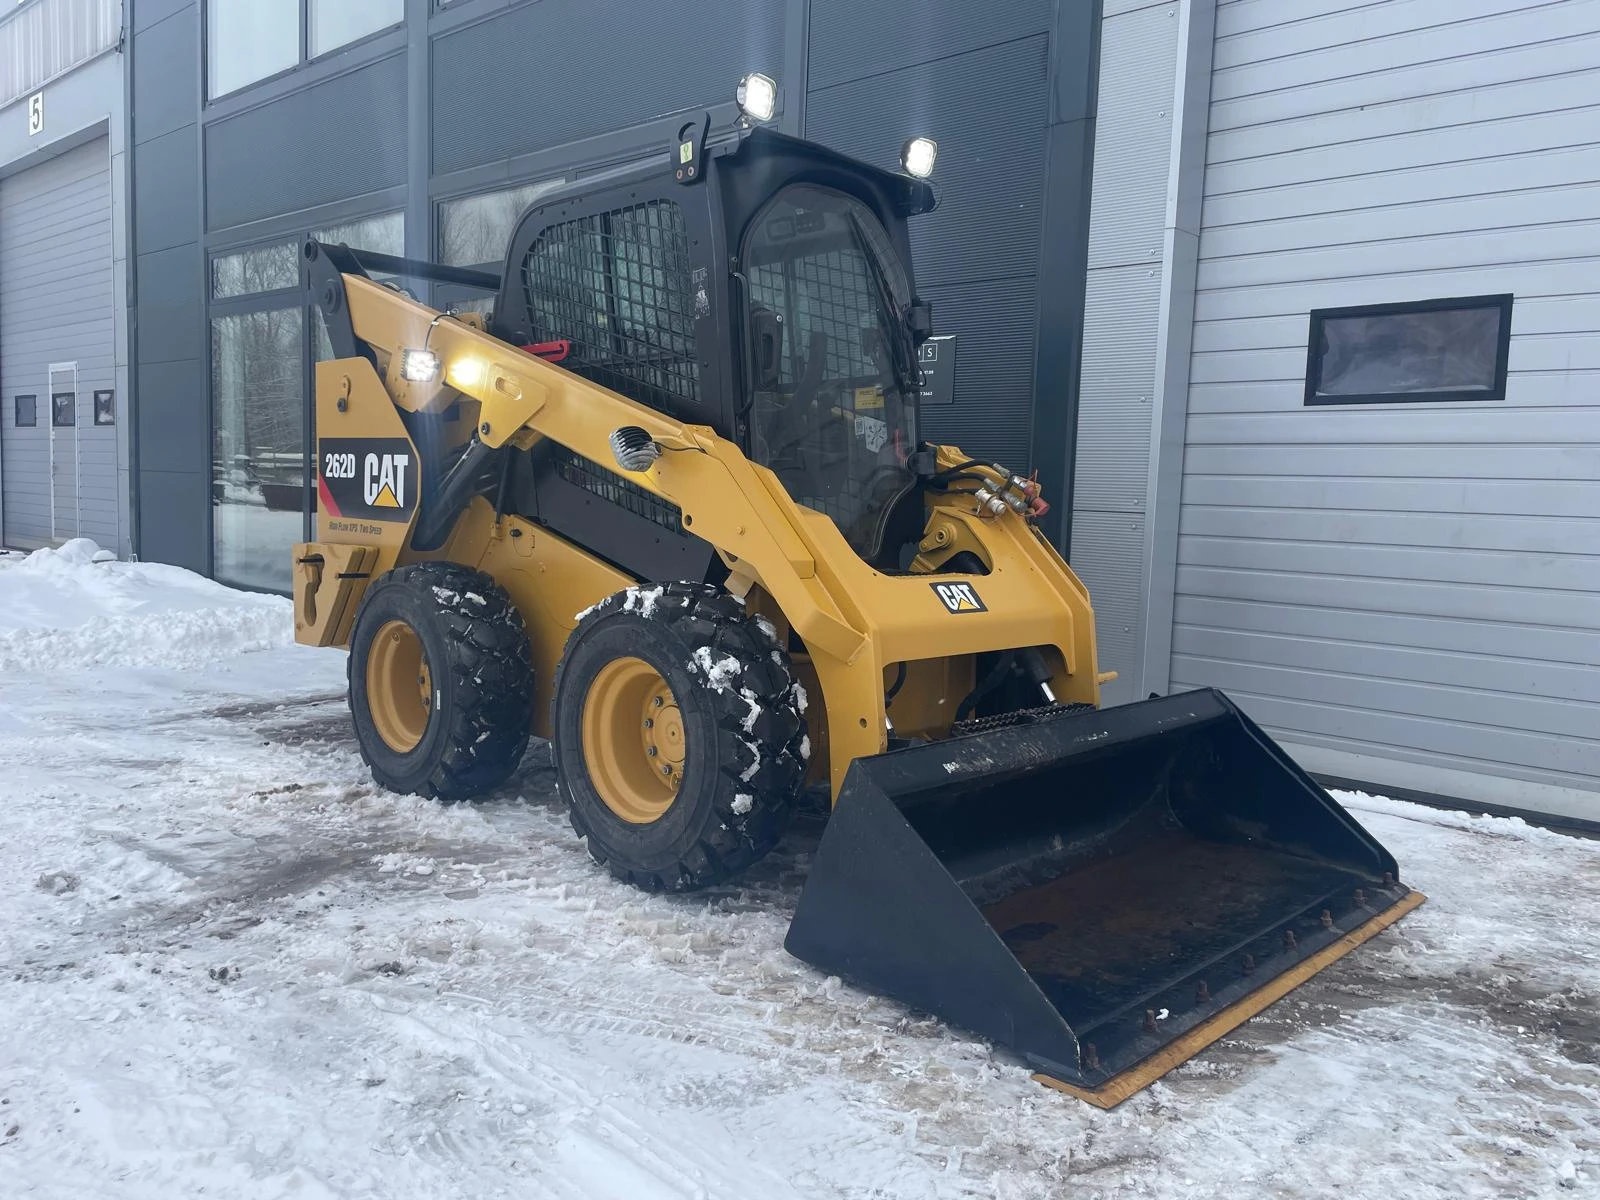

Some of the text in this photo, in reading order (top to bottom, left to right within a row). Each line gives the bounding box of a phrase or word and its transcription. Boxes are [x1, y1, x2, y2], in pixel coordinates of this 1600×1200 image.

[32, 97, 40, 130] 5
[325, 453, 356, 478] 262D
[363, 453, 409, 508] CAT
[936, 584, 981, 611] CAT
